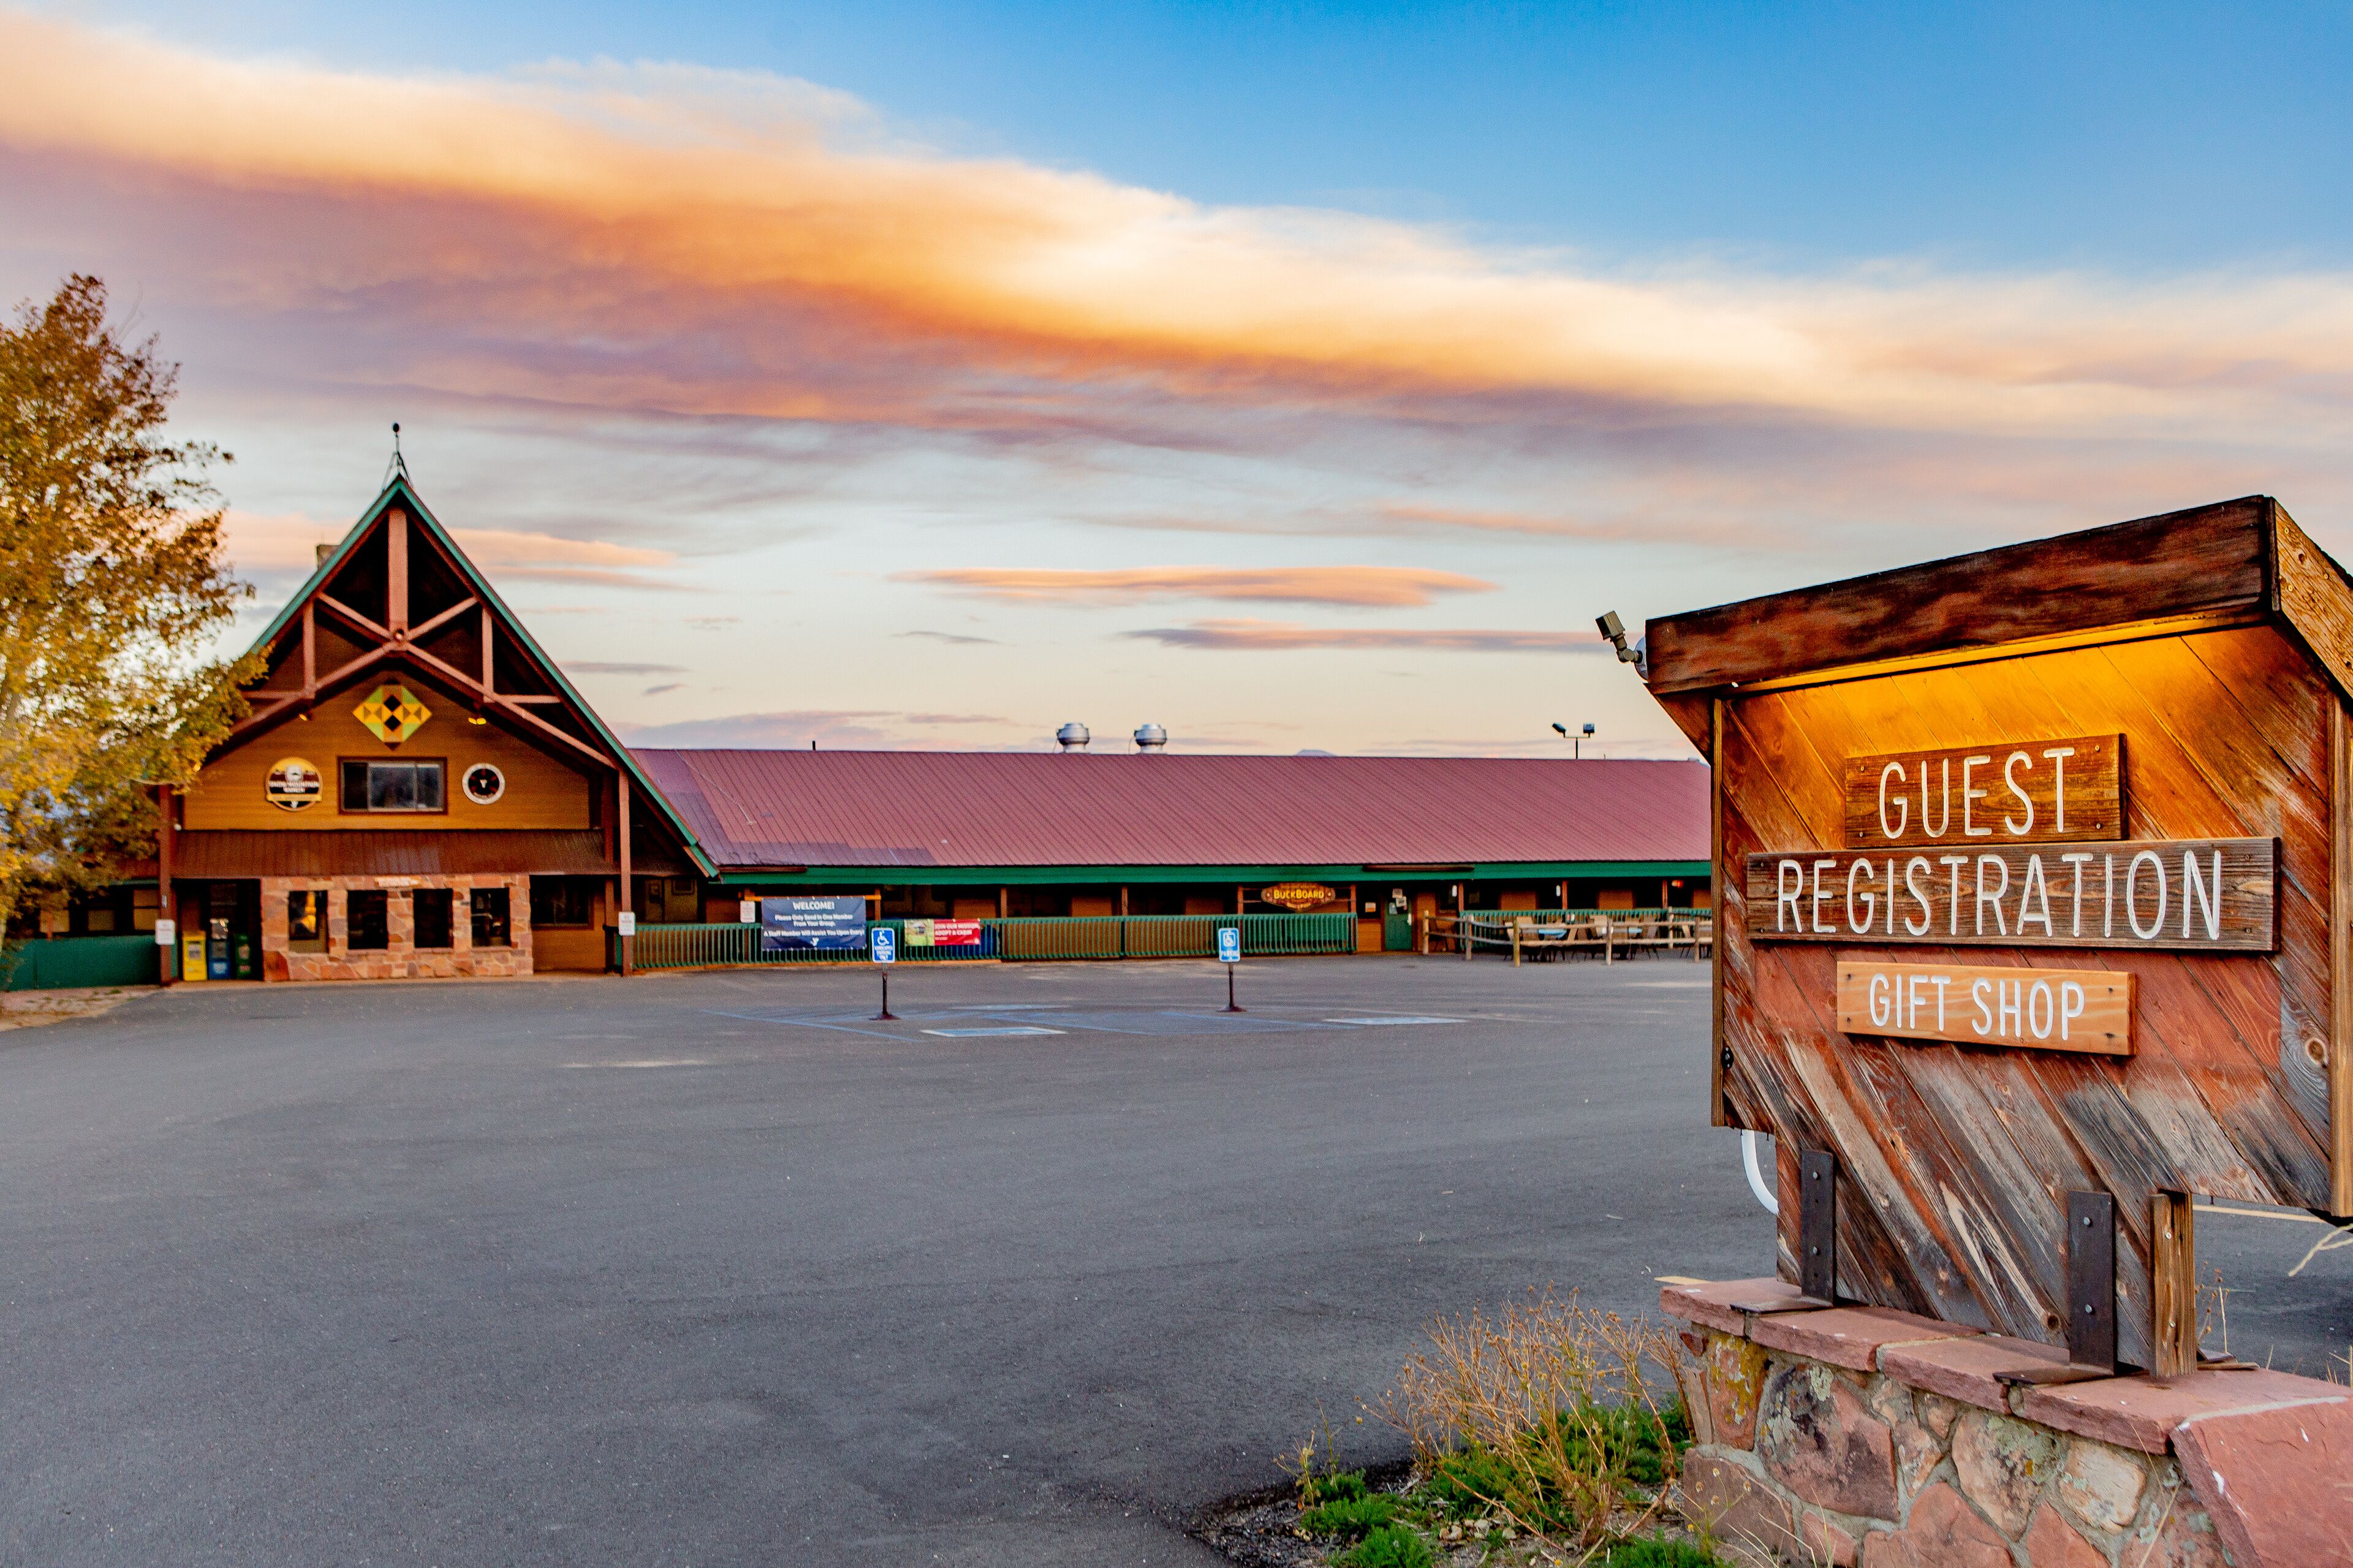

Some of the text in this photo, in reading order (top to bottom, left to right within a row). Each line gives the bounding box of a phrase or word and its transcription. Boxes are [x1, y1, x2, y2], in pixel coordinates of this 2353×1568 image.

[1879, 746, 2075, 839] GUEST
[792, 901, 835, 910] WELCOME!
[1777, 849, 2221, 941] REGISTRATION
[1870, 972, 2085, 1041] GIFT SHOP
